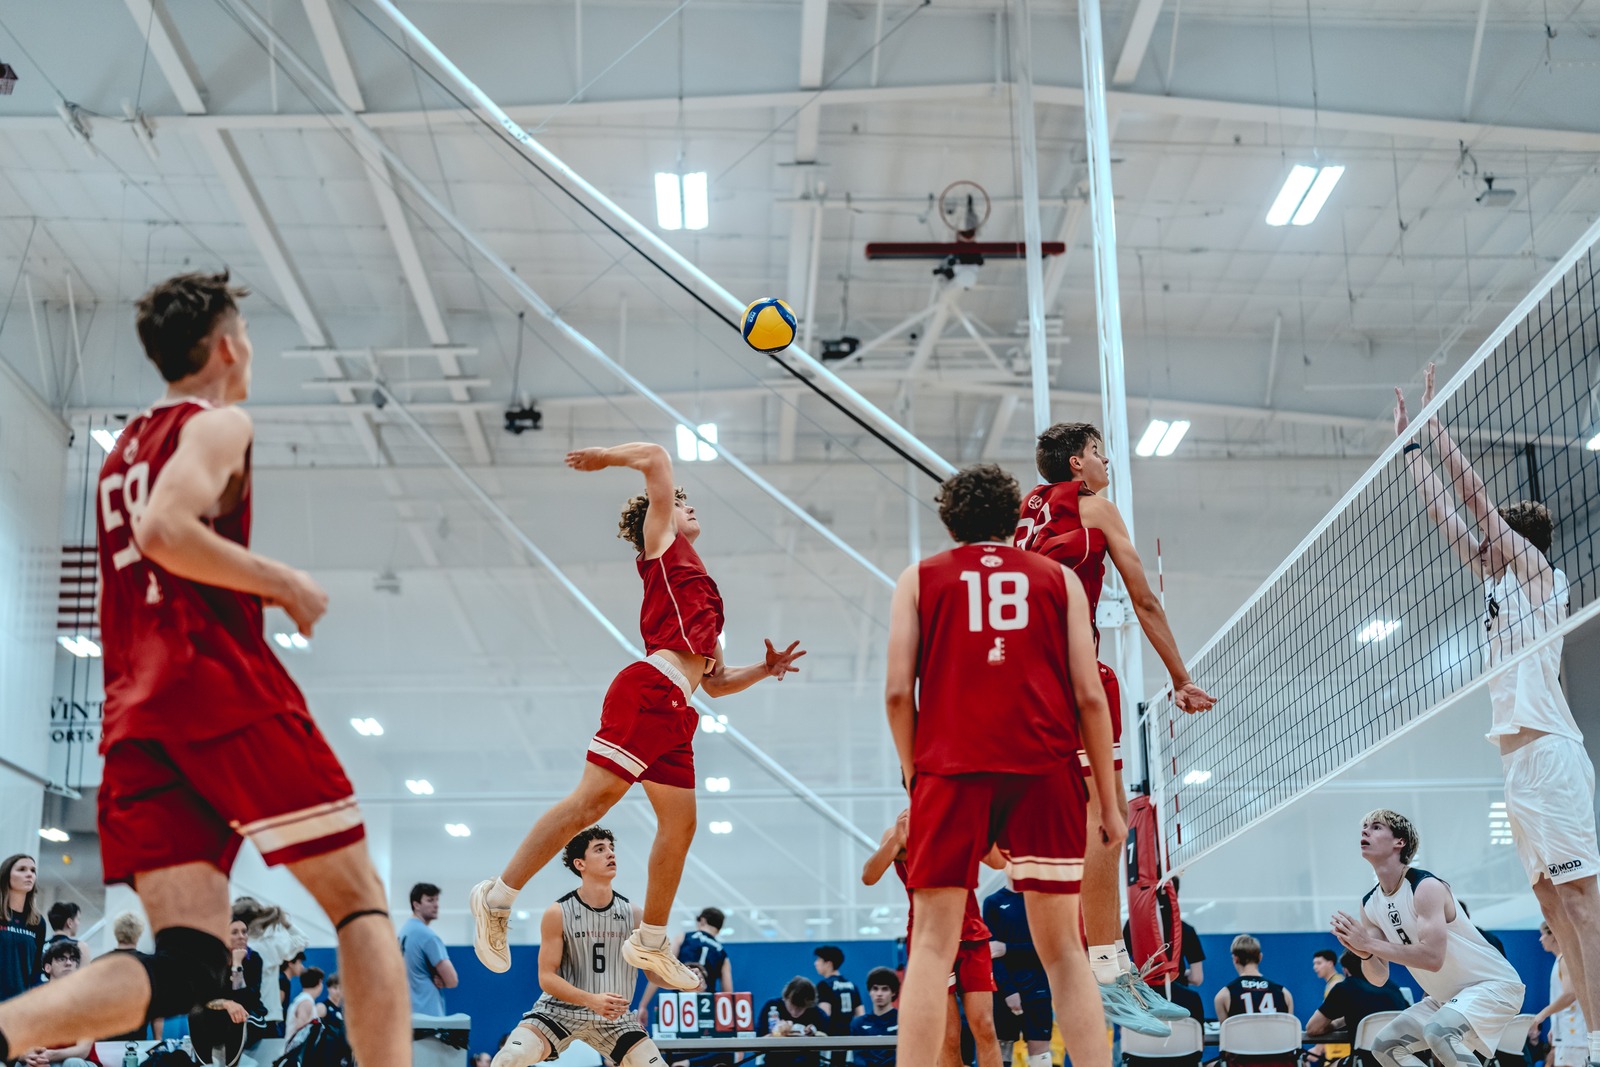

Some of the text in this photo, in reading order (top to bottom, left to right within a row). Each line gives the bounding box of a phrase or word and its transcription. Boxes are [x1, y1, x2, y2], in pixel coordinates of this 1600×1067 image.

[959, 570, 1030, 632] 18
[1558, 859, 1582, 872] MOD
[592, 942, 606, 974] 6
[662, 996, 752, 1028] 06 2 09
[1240, 991, 1277, 1014] 14
